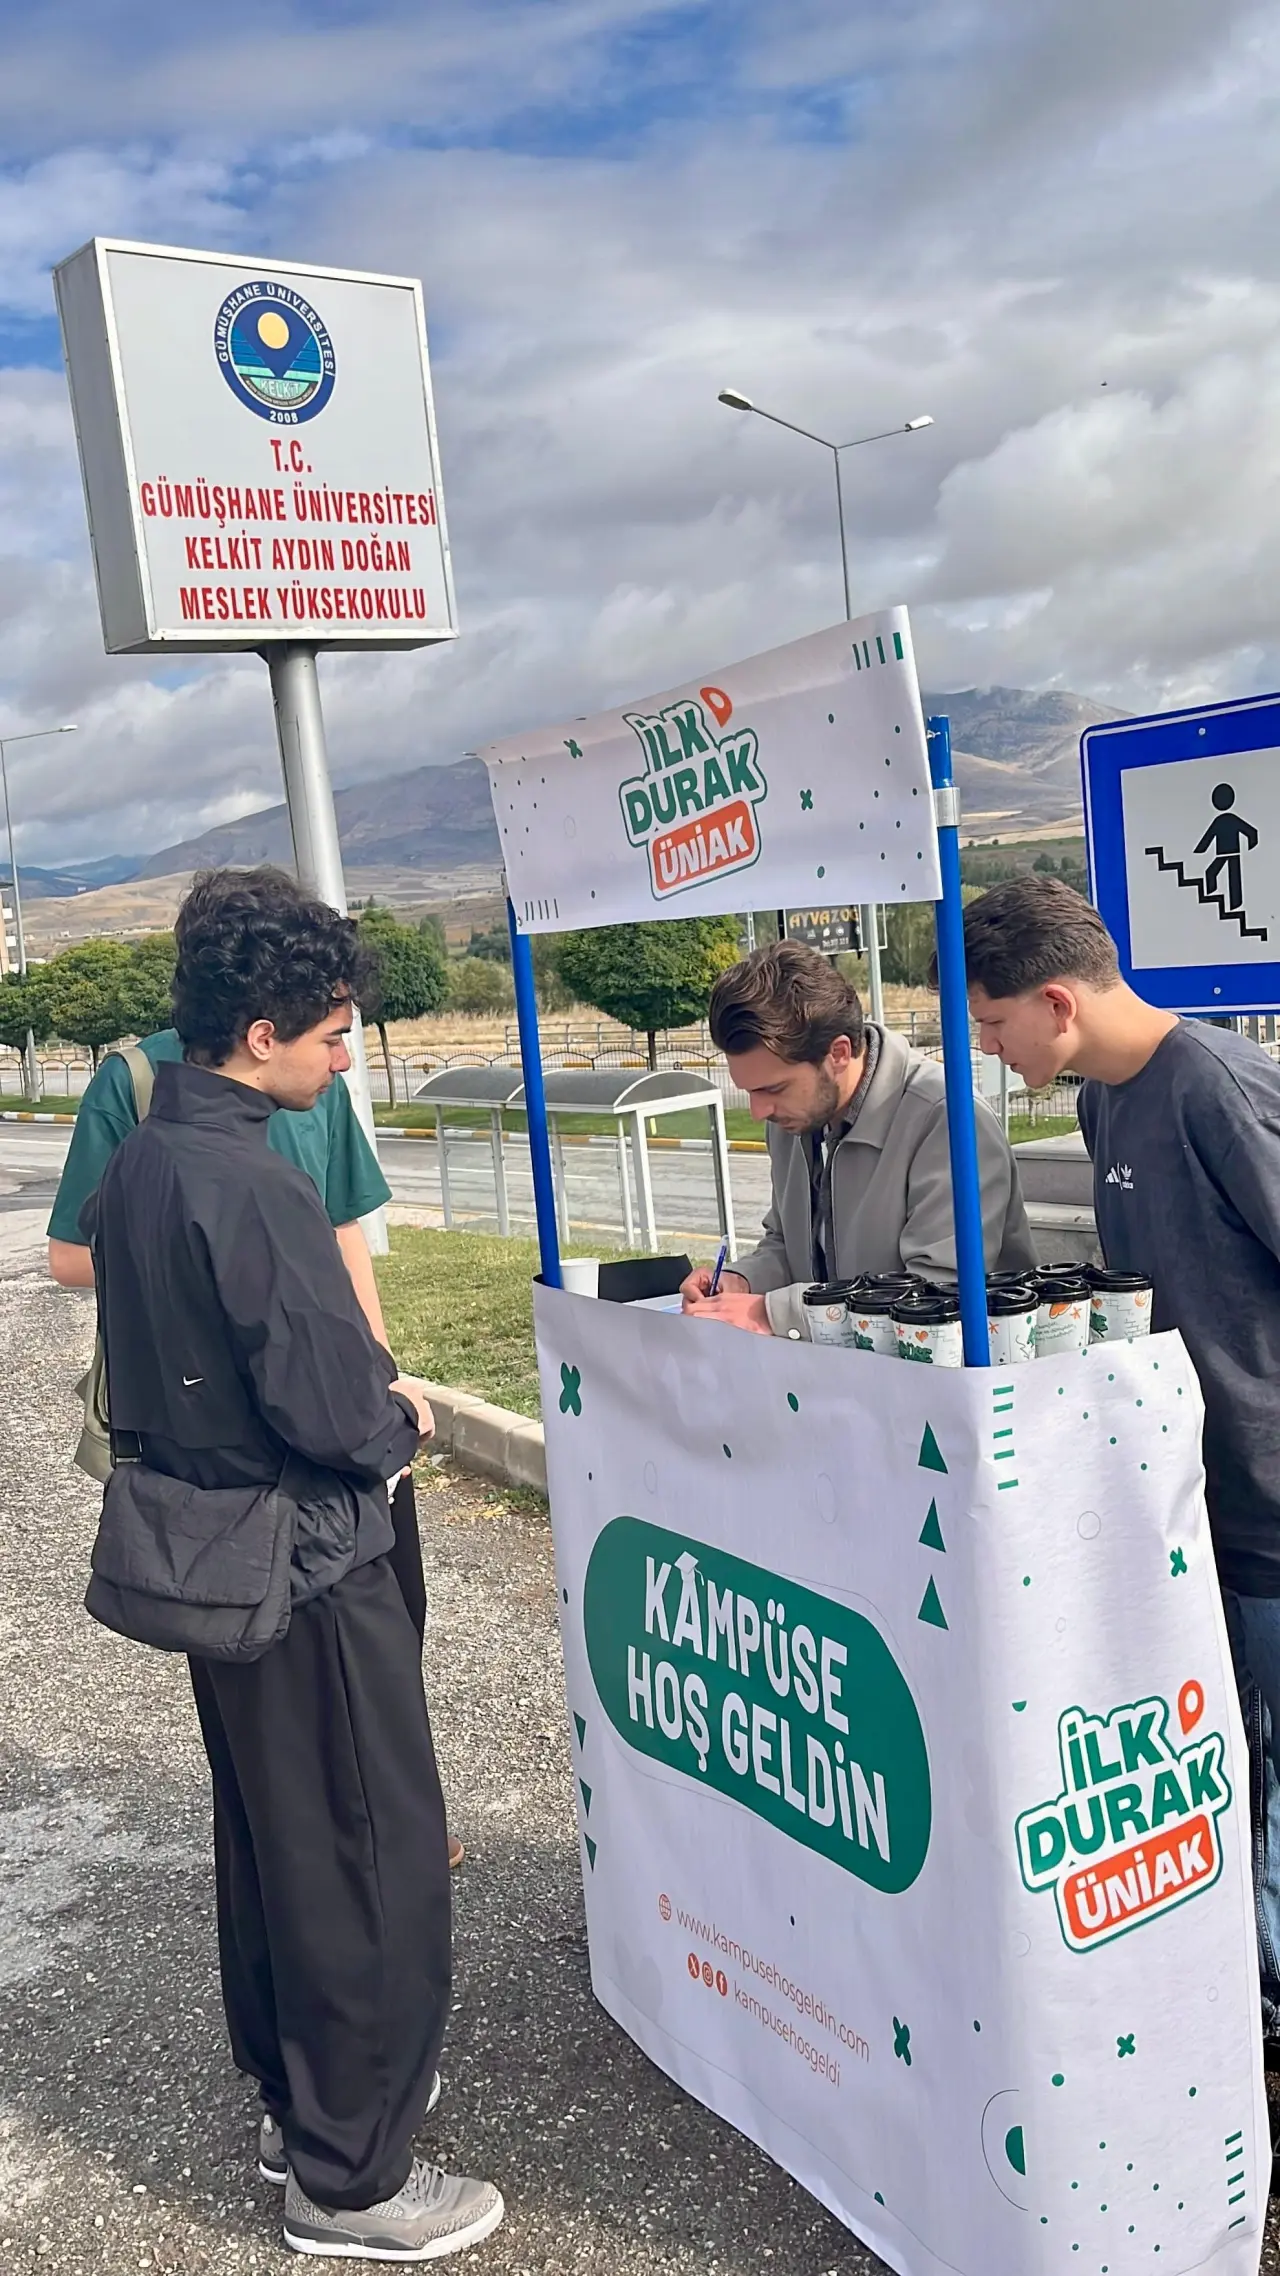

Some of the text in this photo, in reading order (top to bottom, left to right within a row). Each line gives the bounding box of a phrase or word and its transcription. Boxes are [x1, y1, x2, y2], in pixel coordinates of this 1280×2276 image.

[215, 284, 262, 363] GÜMÜŞHANE
[269, 410, 299, 424] 2008
[269, 439, 312, 473] T.C.
[141, 475, 437, 528] GÜMÜŞHANE ÜNİVERSİTESİ
[184, 529, 412, 572] KELKİT AYDIN DOĞAN
[179, 579, 427, 620] MESLEK YÜKSEKOKULU
[633, 706, 710, 772] İLK
[624, 742, 760, 836] DURAK
[657, 815, 750, 884] ÜNİAK
[627, 1644, 891, 1863] HOŞ GELDİN
[1066, 1710, 1164, 1792] İLK
[1026, 1746, 1223, 1877] DURAK
[1074, 1831, 1209, 1930] ÜNİAK
[676, 1907, 870, 2063] www.kampusehosgeldin.com
[733, 1980, 841, 2088] kampusehosgeldi
